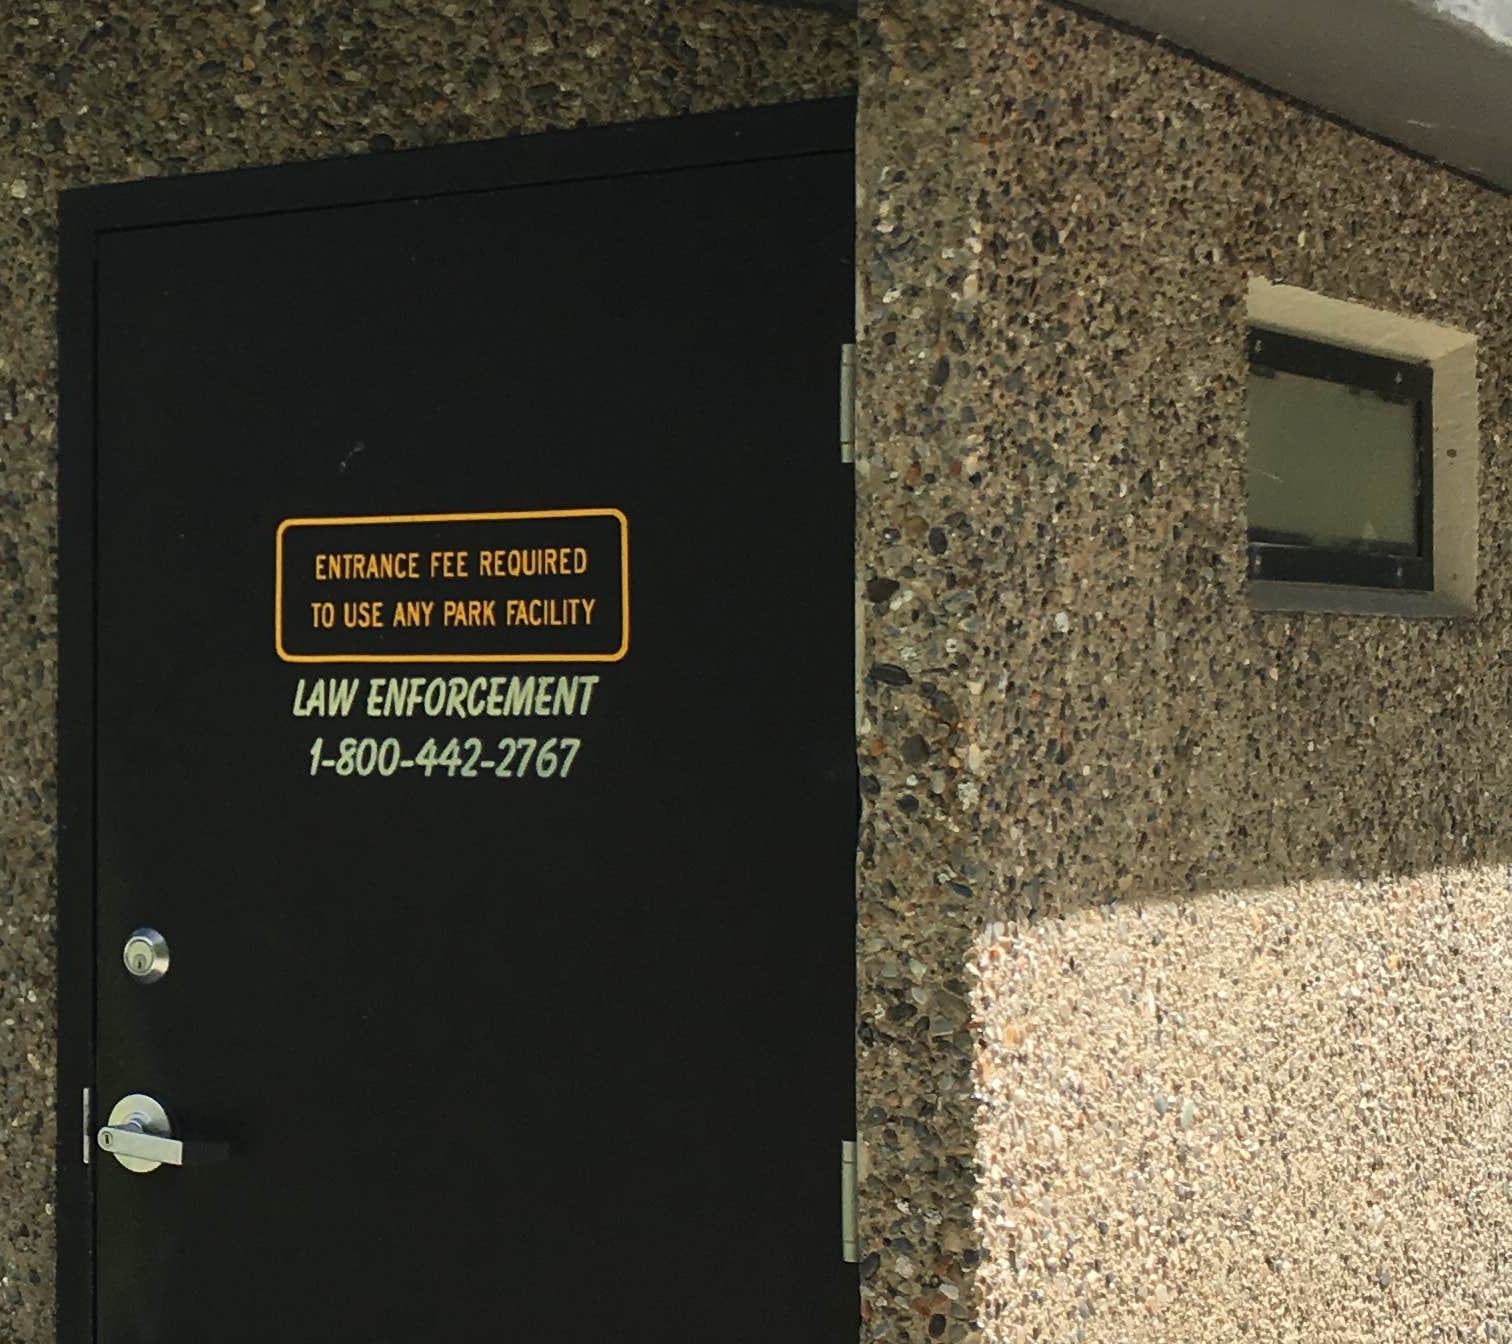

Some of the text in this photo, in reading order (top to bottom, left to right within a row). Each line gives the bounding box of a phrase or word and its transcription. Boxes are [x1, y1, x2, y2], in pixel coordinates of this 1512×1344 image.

[316, 548, 587, 580] ENTRANCE FEE REQUIRED
[312, 599, 595, 628] TO USE ANY PARK FACILITY
[293, 676, 599, 718] LAW ENFORCEMENT
[311, 738, 580, 777] 1-800-442-2767
